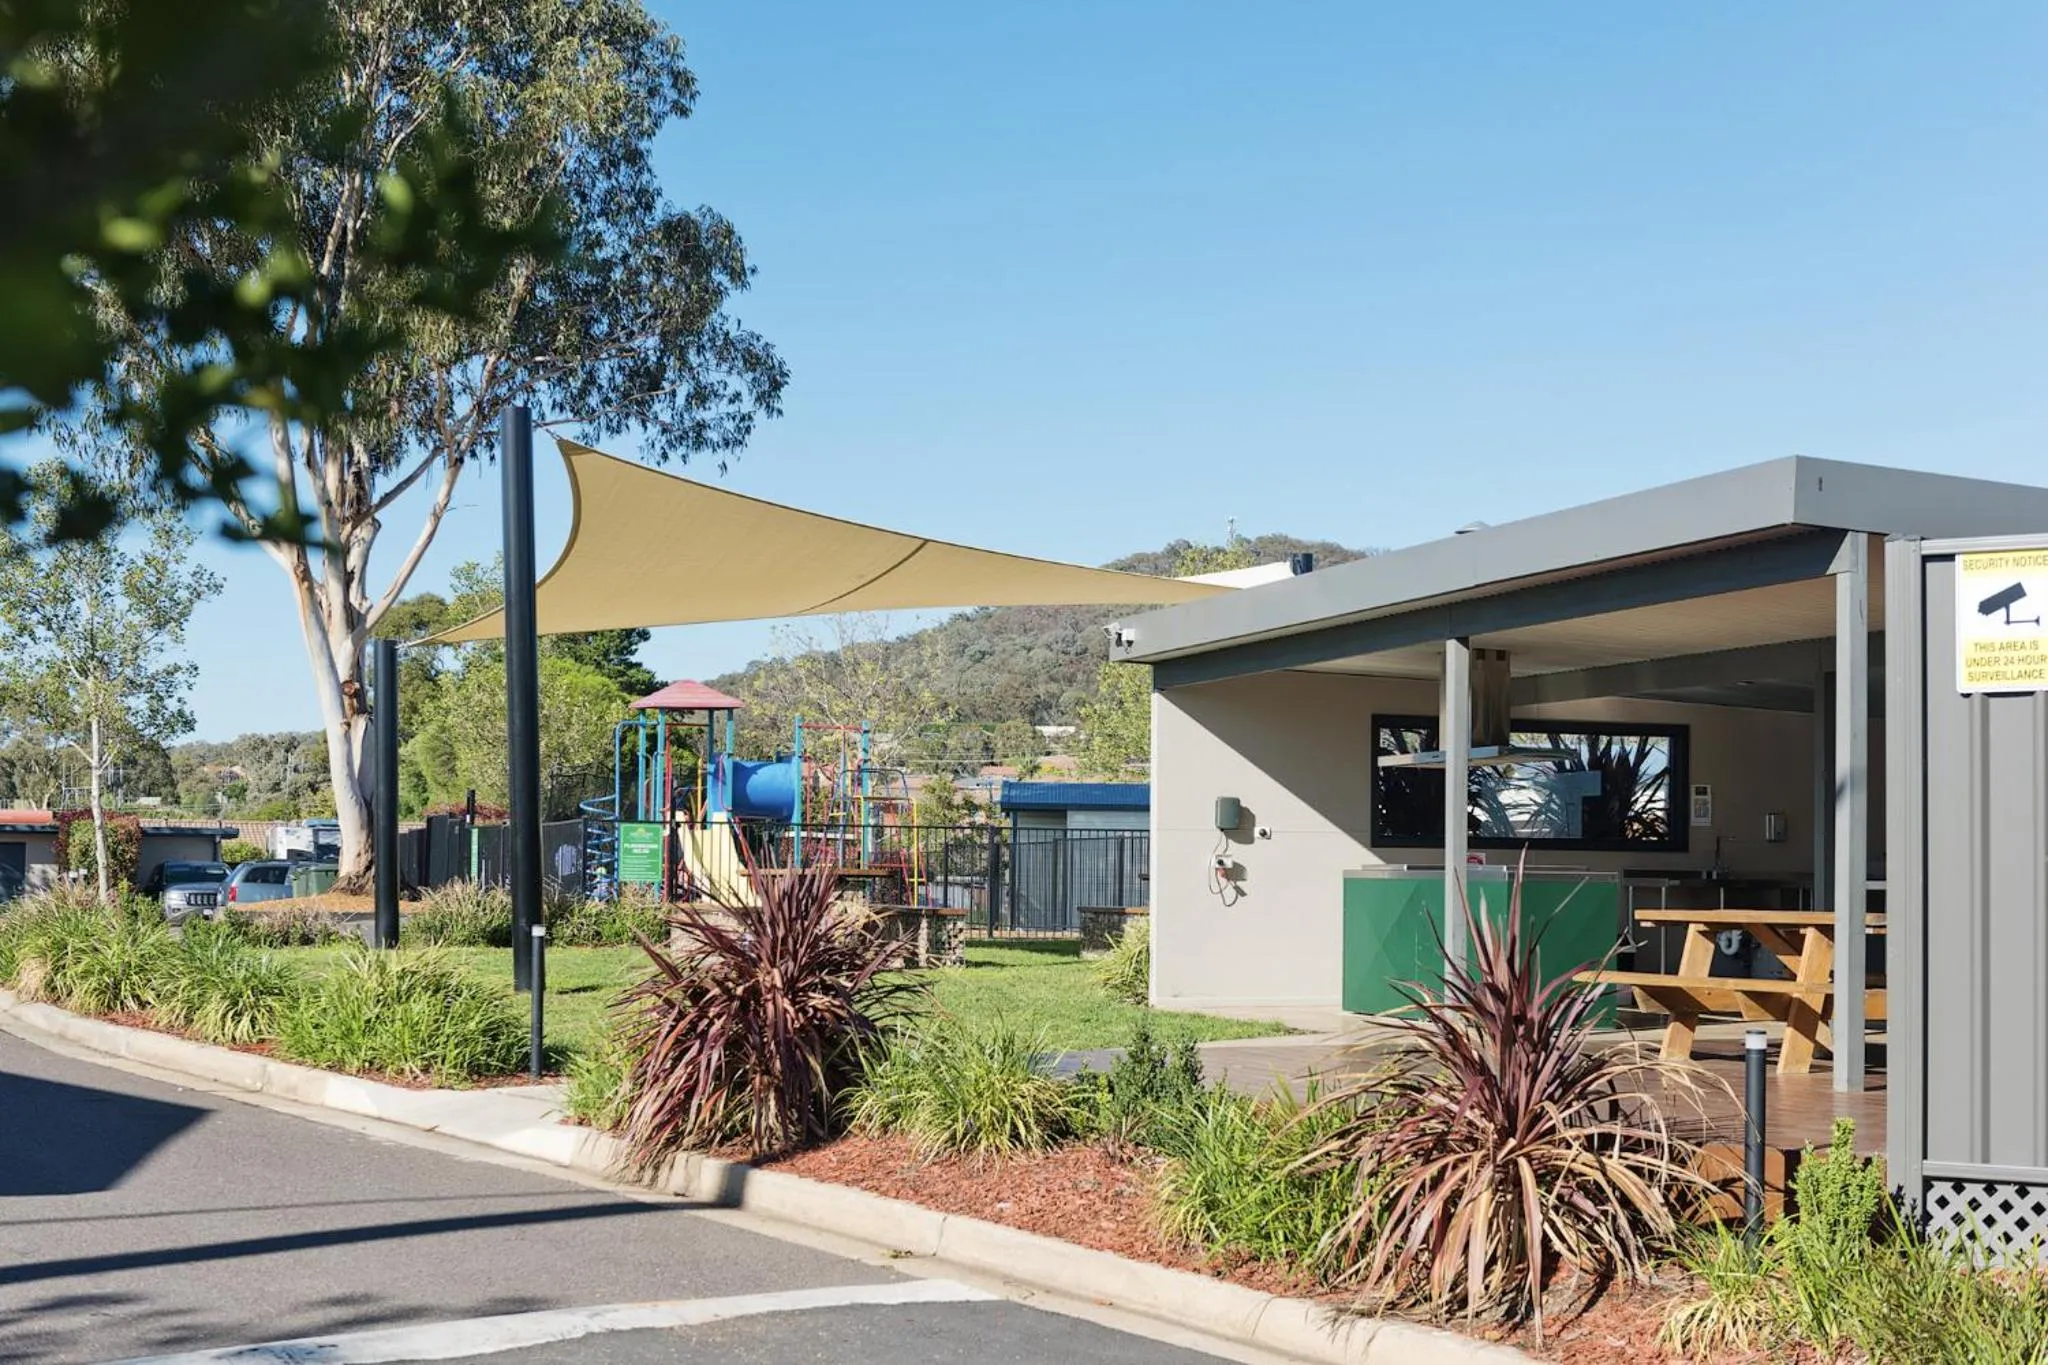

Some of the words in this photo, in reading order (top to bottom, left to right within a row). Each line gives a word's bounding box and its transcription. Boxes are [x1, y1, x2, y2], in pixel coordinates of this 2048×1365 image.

[1963, 558, 2009, 571] SECURITY
[2012, 555, 2048, 567] NOTICE
[1974, 642, 1996, 652] THIS
[1999, 640, 2027, 652] AREA
[2029, 640, 2039, 650] IS
[1966, 656, 2001, 668] UNDER
[2003, 656, 2015, 666] 24
[2017, 654, 2048, 666] HOUR
[1968, 669, 2045, 682] SURVEILLANCE
